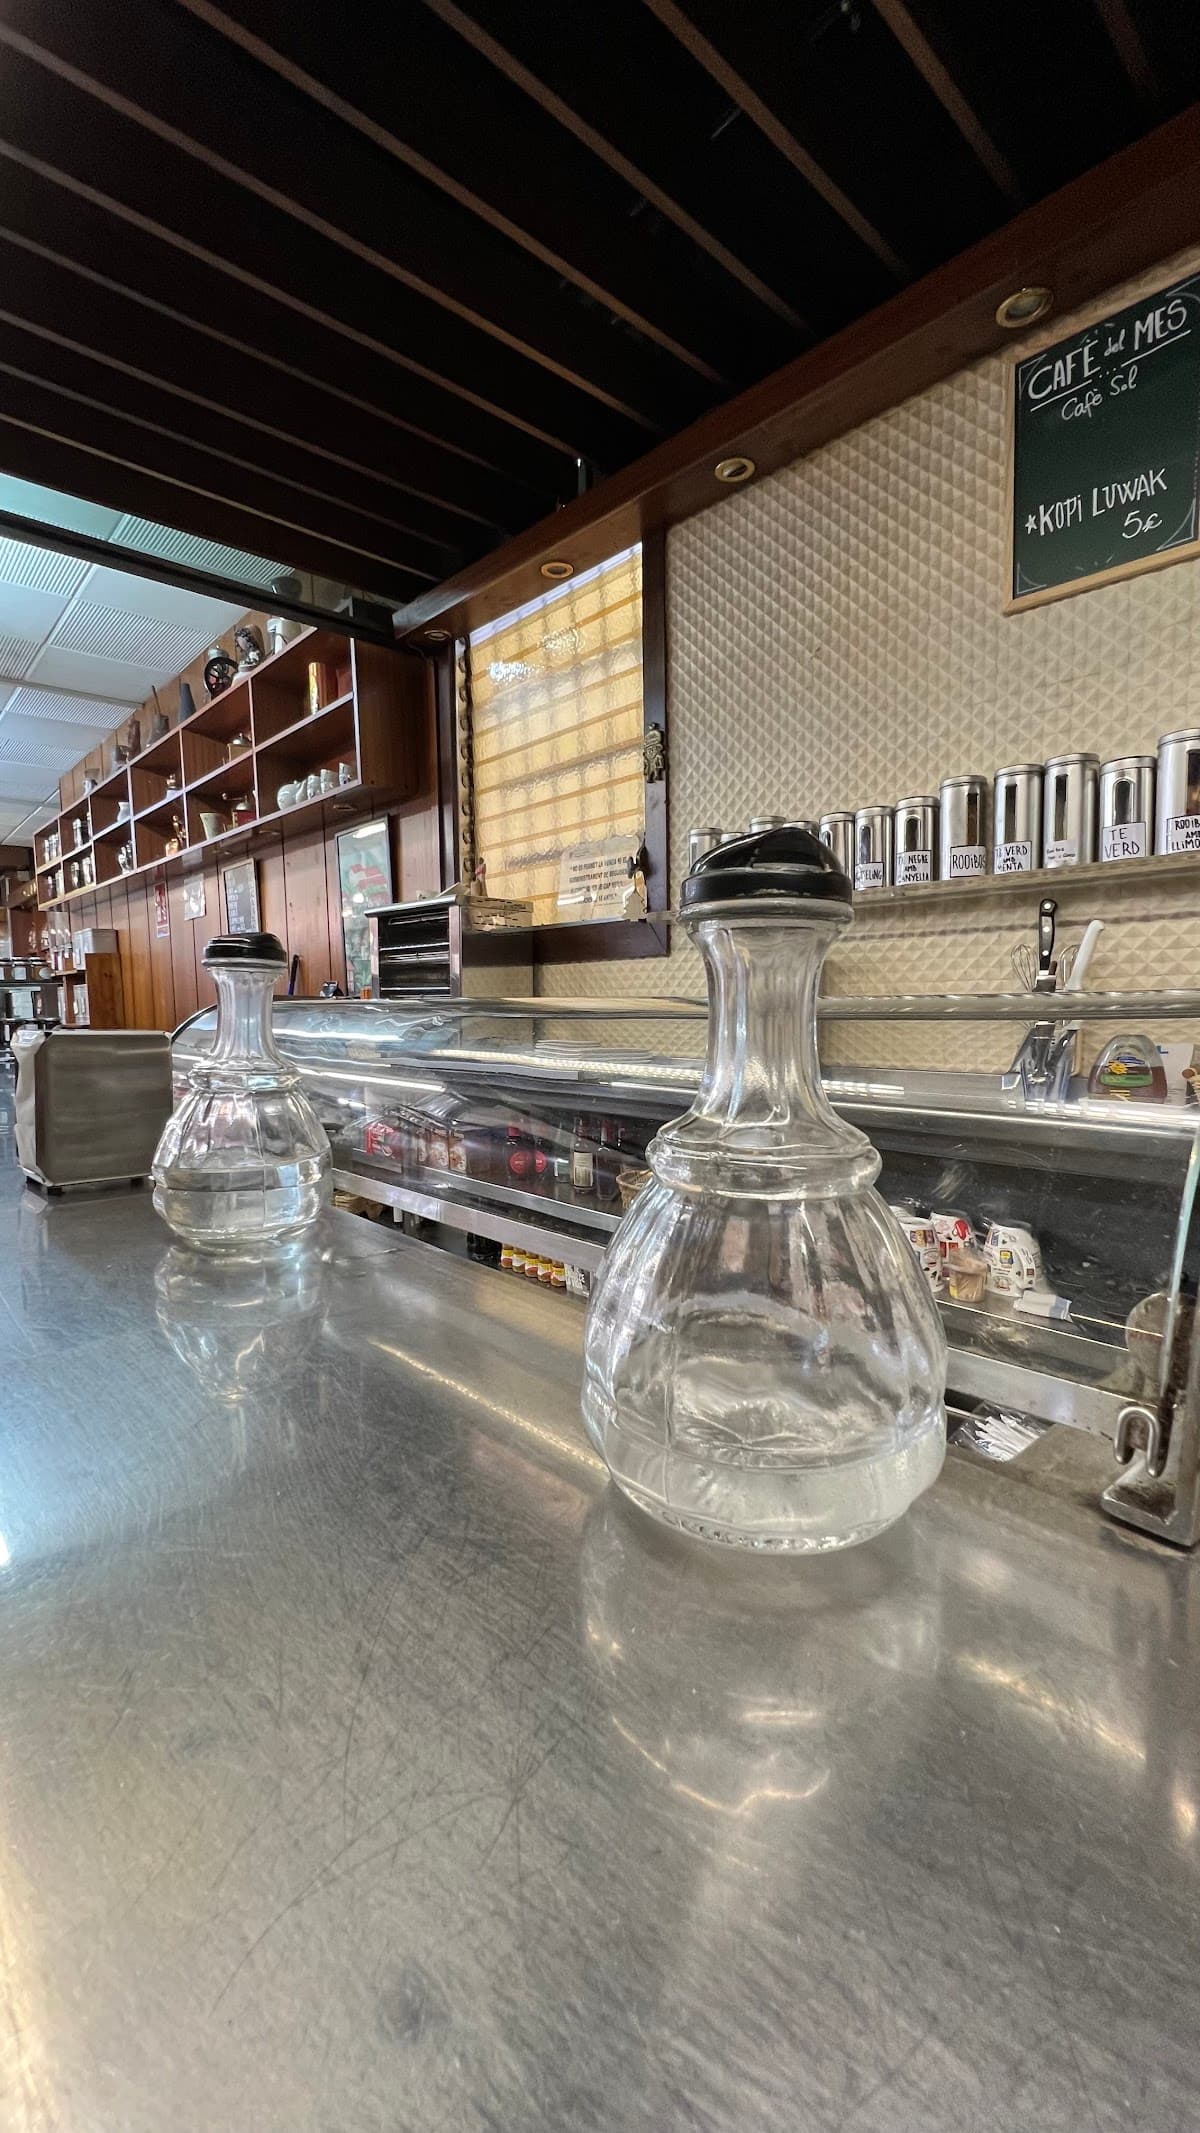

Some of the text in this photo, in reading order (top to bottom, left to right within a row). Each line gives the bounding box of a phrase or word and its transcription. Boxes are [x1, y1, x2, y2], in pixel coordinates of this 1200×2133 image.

[1134, 299, 1187, 351] MES
[1110, 365, 1138, 396] Sol
[1092, 468, 1168, 517] LUWAK
[1122, 510, 1163, 540] 5€
[1109, 827, 1128, 841] TE
[908, 854, 929, 864] NEGRE
[1004, 845, 1028, 857] VERD
[1104, 841, 1140, 859] VERD
